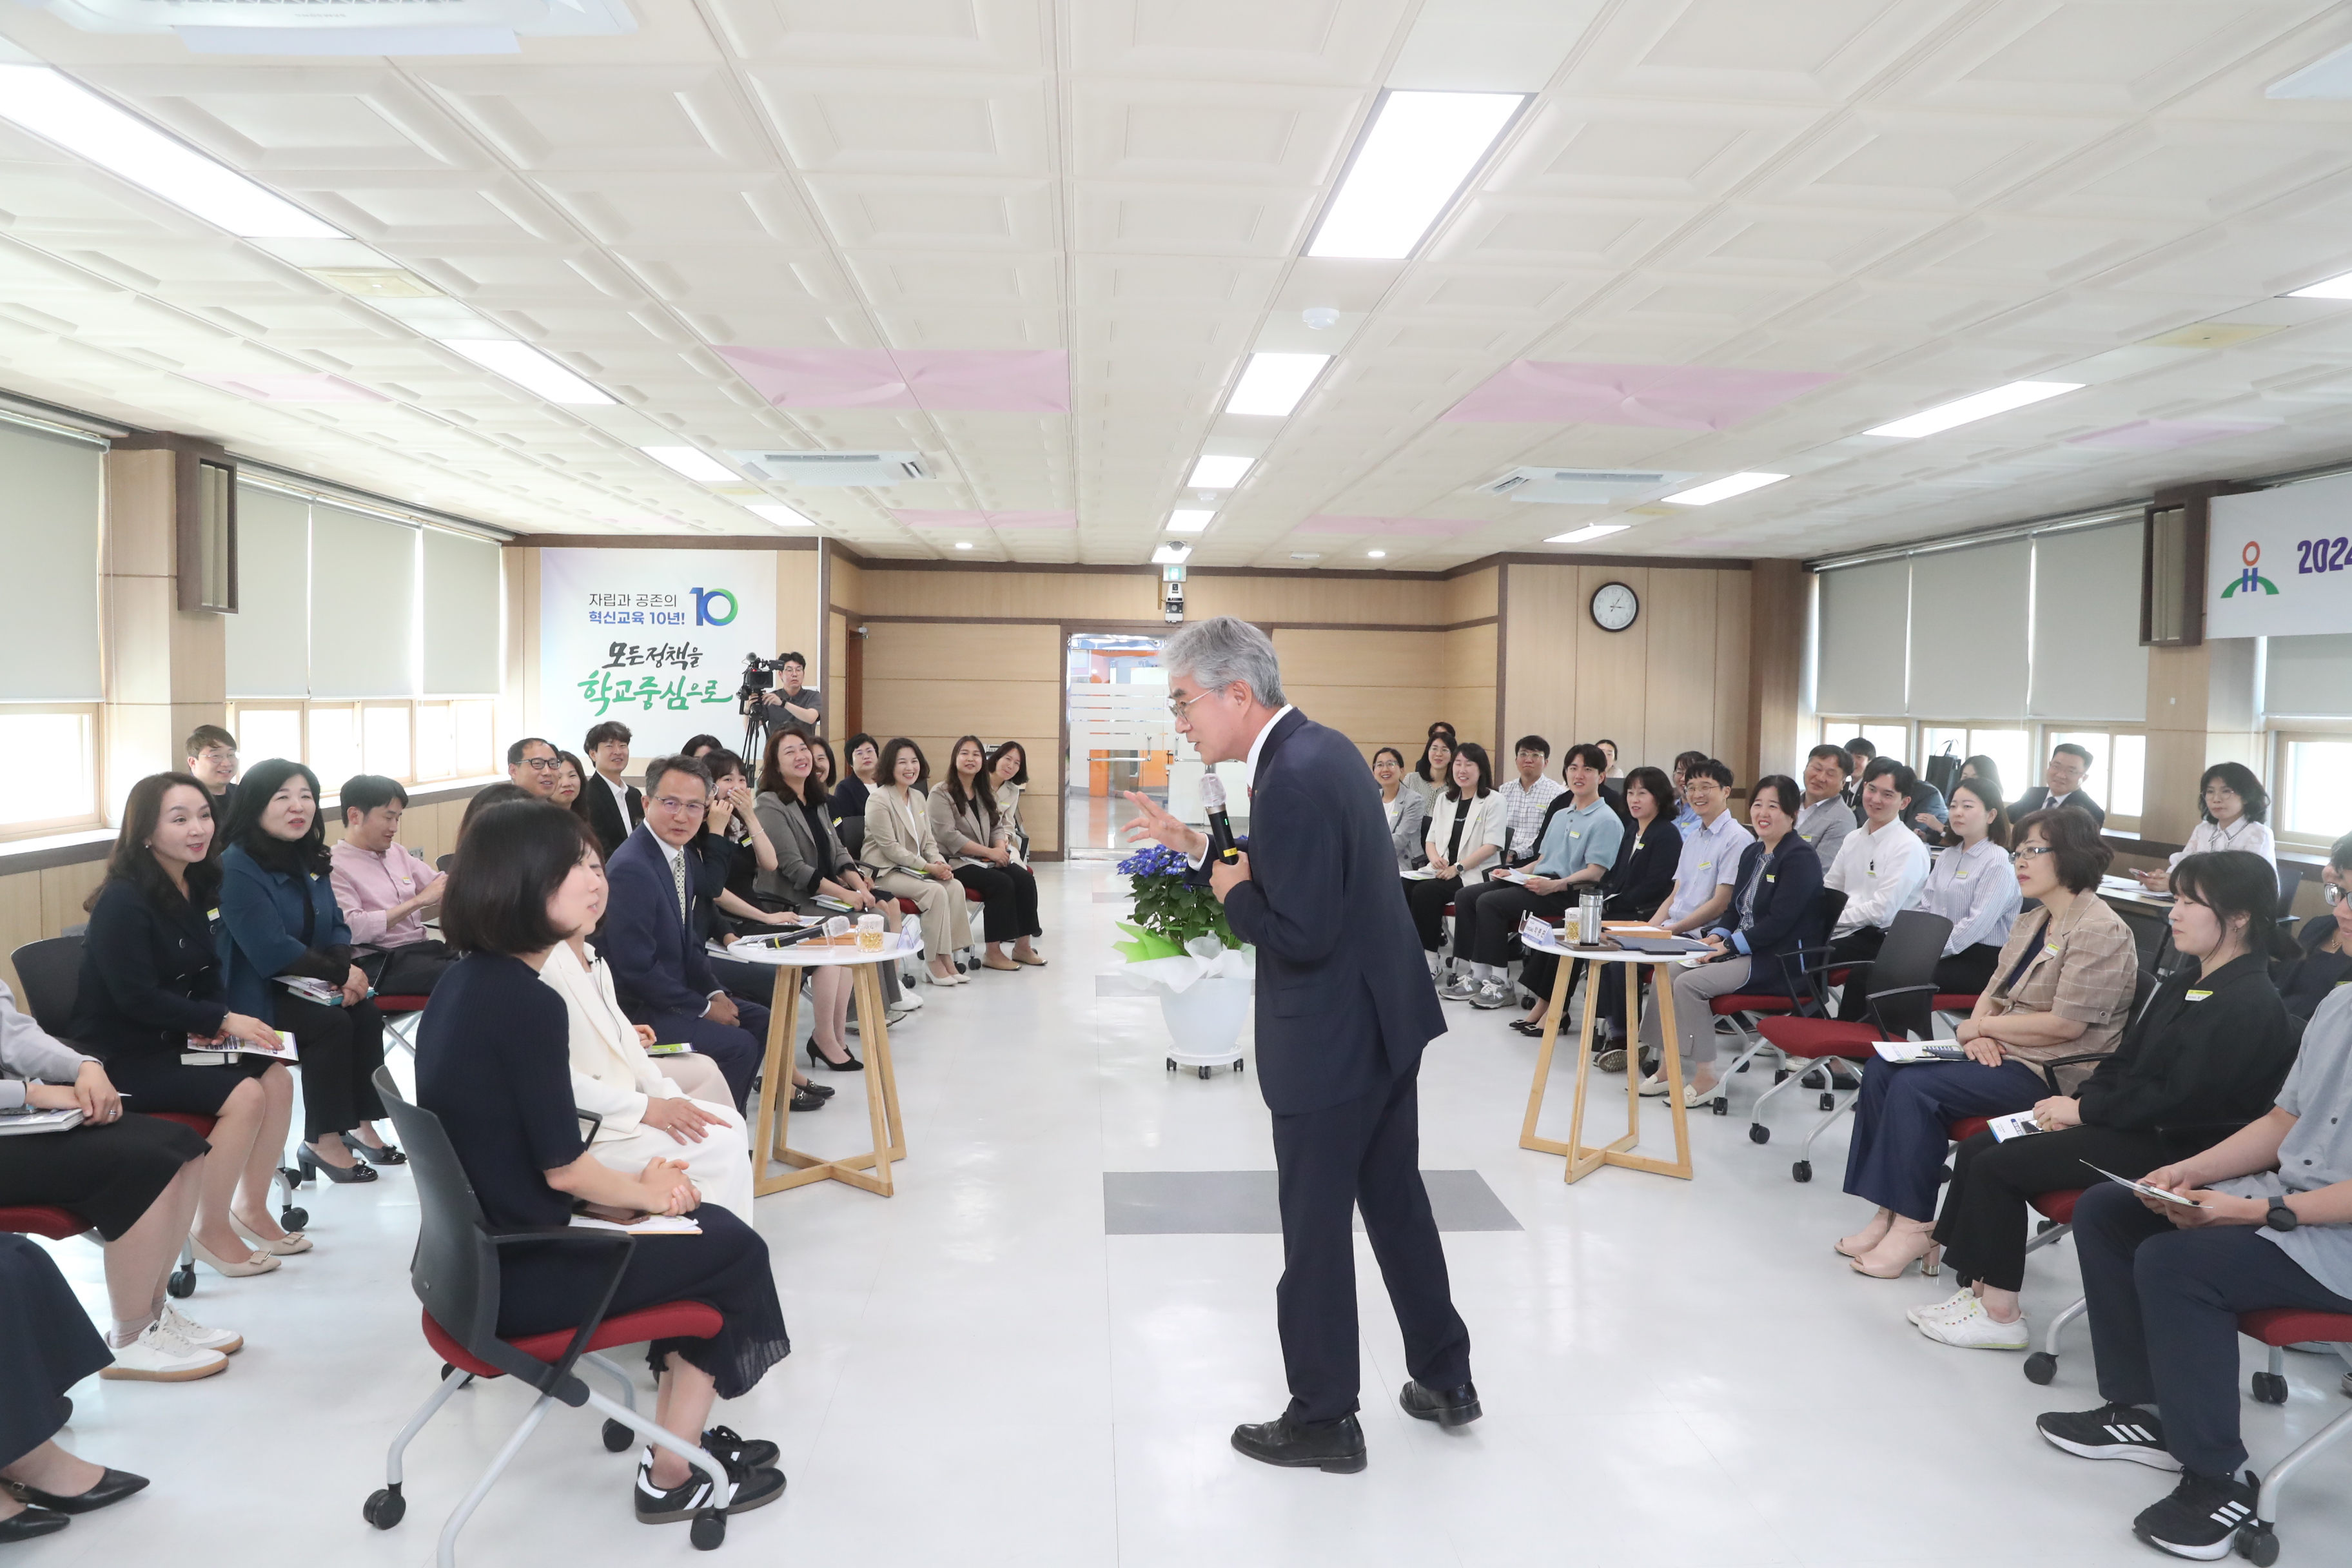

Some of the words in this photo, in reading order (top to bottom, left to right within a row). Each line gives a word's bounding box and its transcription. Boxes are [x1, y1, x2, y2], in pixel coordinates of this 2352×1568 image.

[589, 593, 631, 607] 자립과
[636, 593, 676, 607] 공존의
[689, 587, 739, 627] 10
[589, 611, 645, 625] 혁신교육
[649, 611, 685, 625] 10년!
